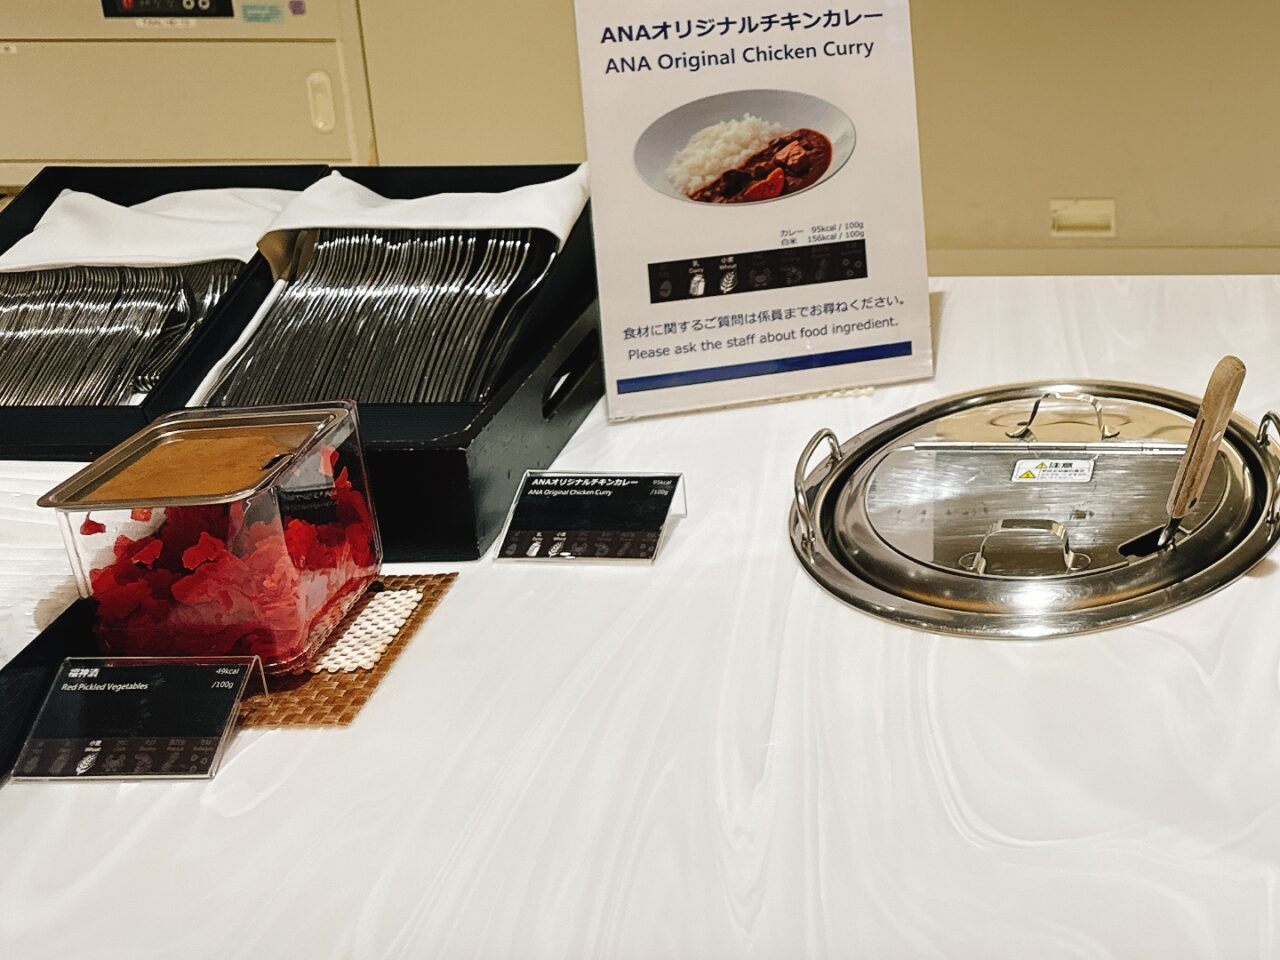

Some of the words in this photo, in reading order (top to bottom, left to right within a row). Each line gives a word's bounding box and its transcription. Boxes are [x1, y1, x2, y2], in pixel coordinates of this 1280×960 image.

[600, 9, 883, 44] ANAオリジナルチキンカレー
[605, 56, 652, 74] ANA
[658, 48, 735, 72] Original
[742, 44, 817, 63] Chicken
[823, 41, 874, 58] Curry
[811, 224, 836, 233] 95kcal
[845, 221, 864, 230] 100g
[846, 230, 865, 239] 100g
[623, 295, 905, 340] 食材に関するご質問は係員までお尋ねください。
[628, 345, 671, 360] Please
[674, 342, 697, 354] ask
[701, 339, 723, 351] the
[727, 333, 755, 348] staff
[760, 329, 796, 344] about
[800, 325, 828, 338] food
[832, 317, 898, 335] ingredient.
[532, 478, 639, 486] ANAオリジナルチキンカレー
[544, 489, 569, 497] Original
[594, 489, 613, 497] Curry
[61, 682, 77, 691] Red
[77, 682, 106, 691] Pickled
[107, 682, 149, 692] Vegetables
[211, 681, 234, 689] /100g
